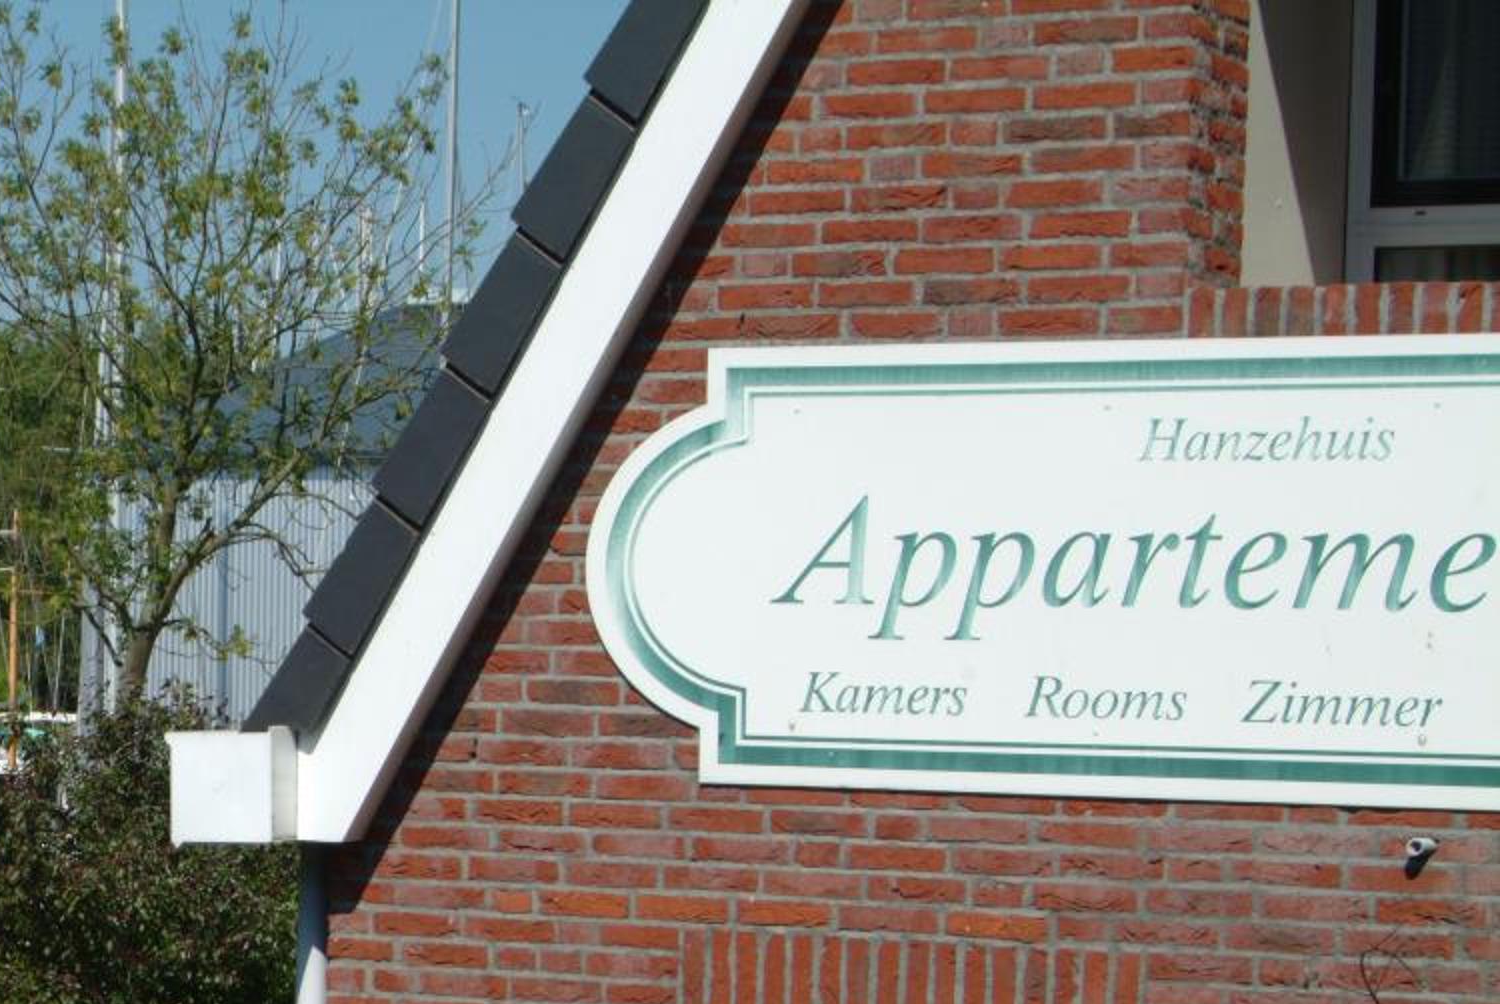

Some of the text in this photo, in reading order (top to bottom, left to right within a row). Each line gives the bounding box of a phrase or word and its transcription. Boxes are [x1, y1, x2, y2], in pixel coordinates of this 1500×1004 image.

[1138, 415, 1396, 465] Hanzehuis
[801, 671, 1444, 731] Kamers Rooms Zimmer
